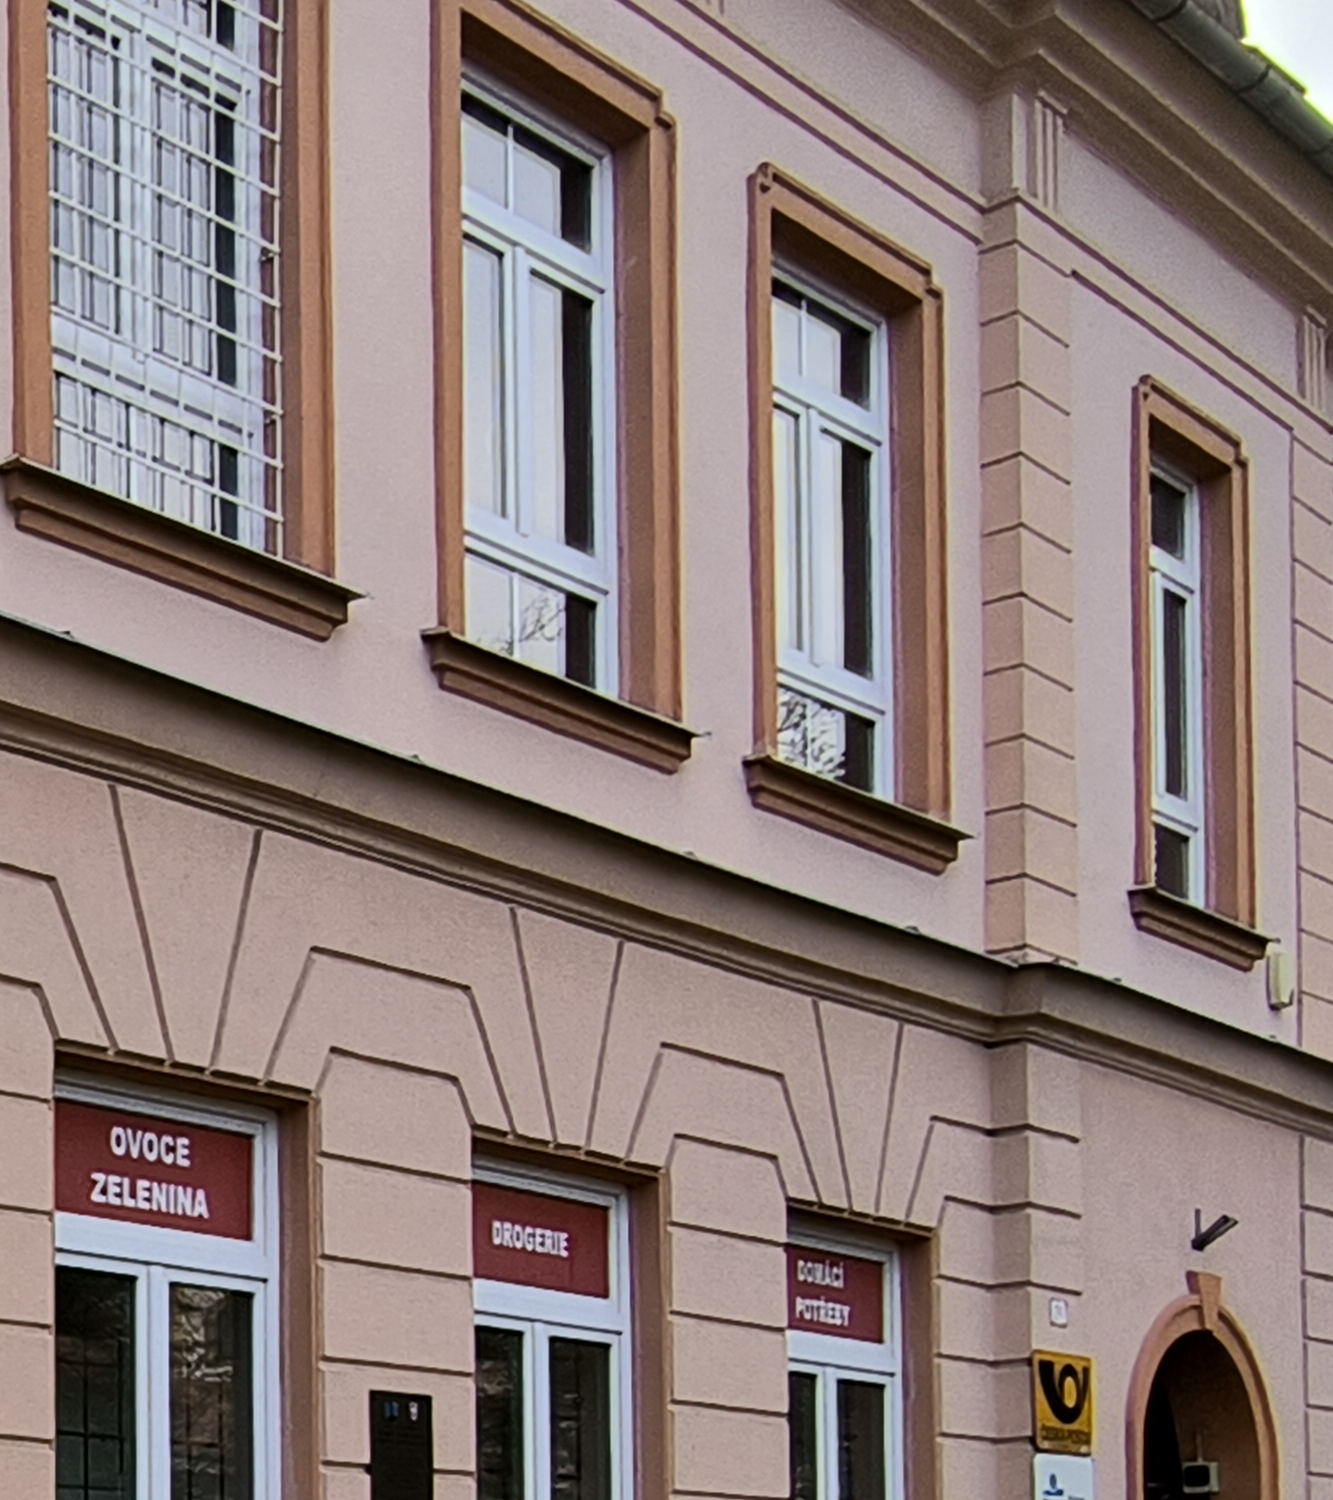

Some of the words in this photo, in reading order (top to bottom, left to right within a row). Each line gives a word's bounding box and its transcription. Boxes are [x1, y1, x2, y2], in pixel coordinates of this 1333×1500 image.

[110, 1125, 191, 1168] OVOCE
[89, 1172, 210, 1220] ZELENINA
[491, 1219, 570, 1259] DROGERIE
[796, 1258, 845, 1289] DOMÁCÍ
[795, 1295, 851, 1328] POTŘEBY
